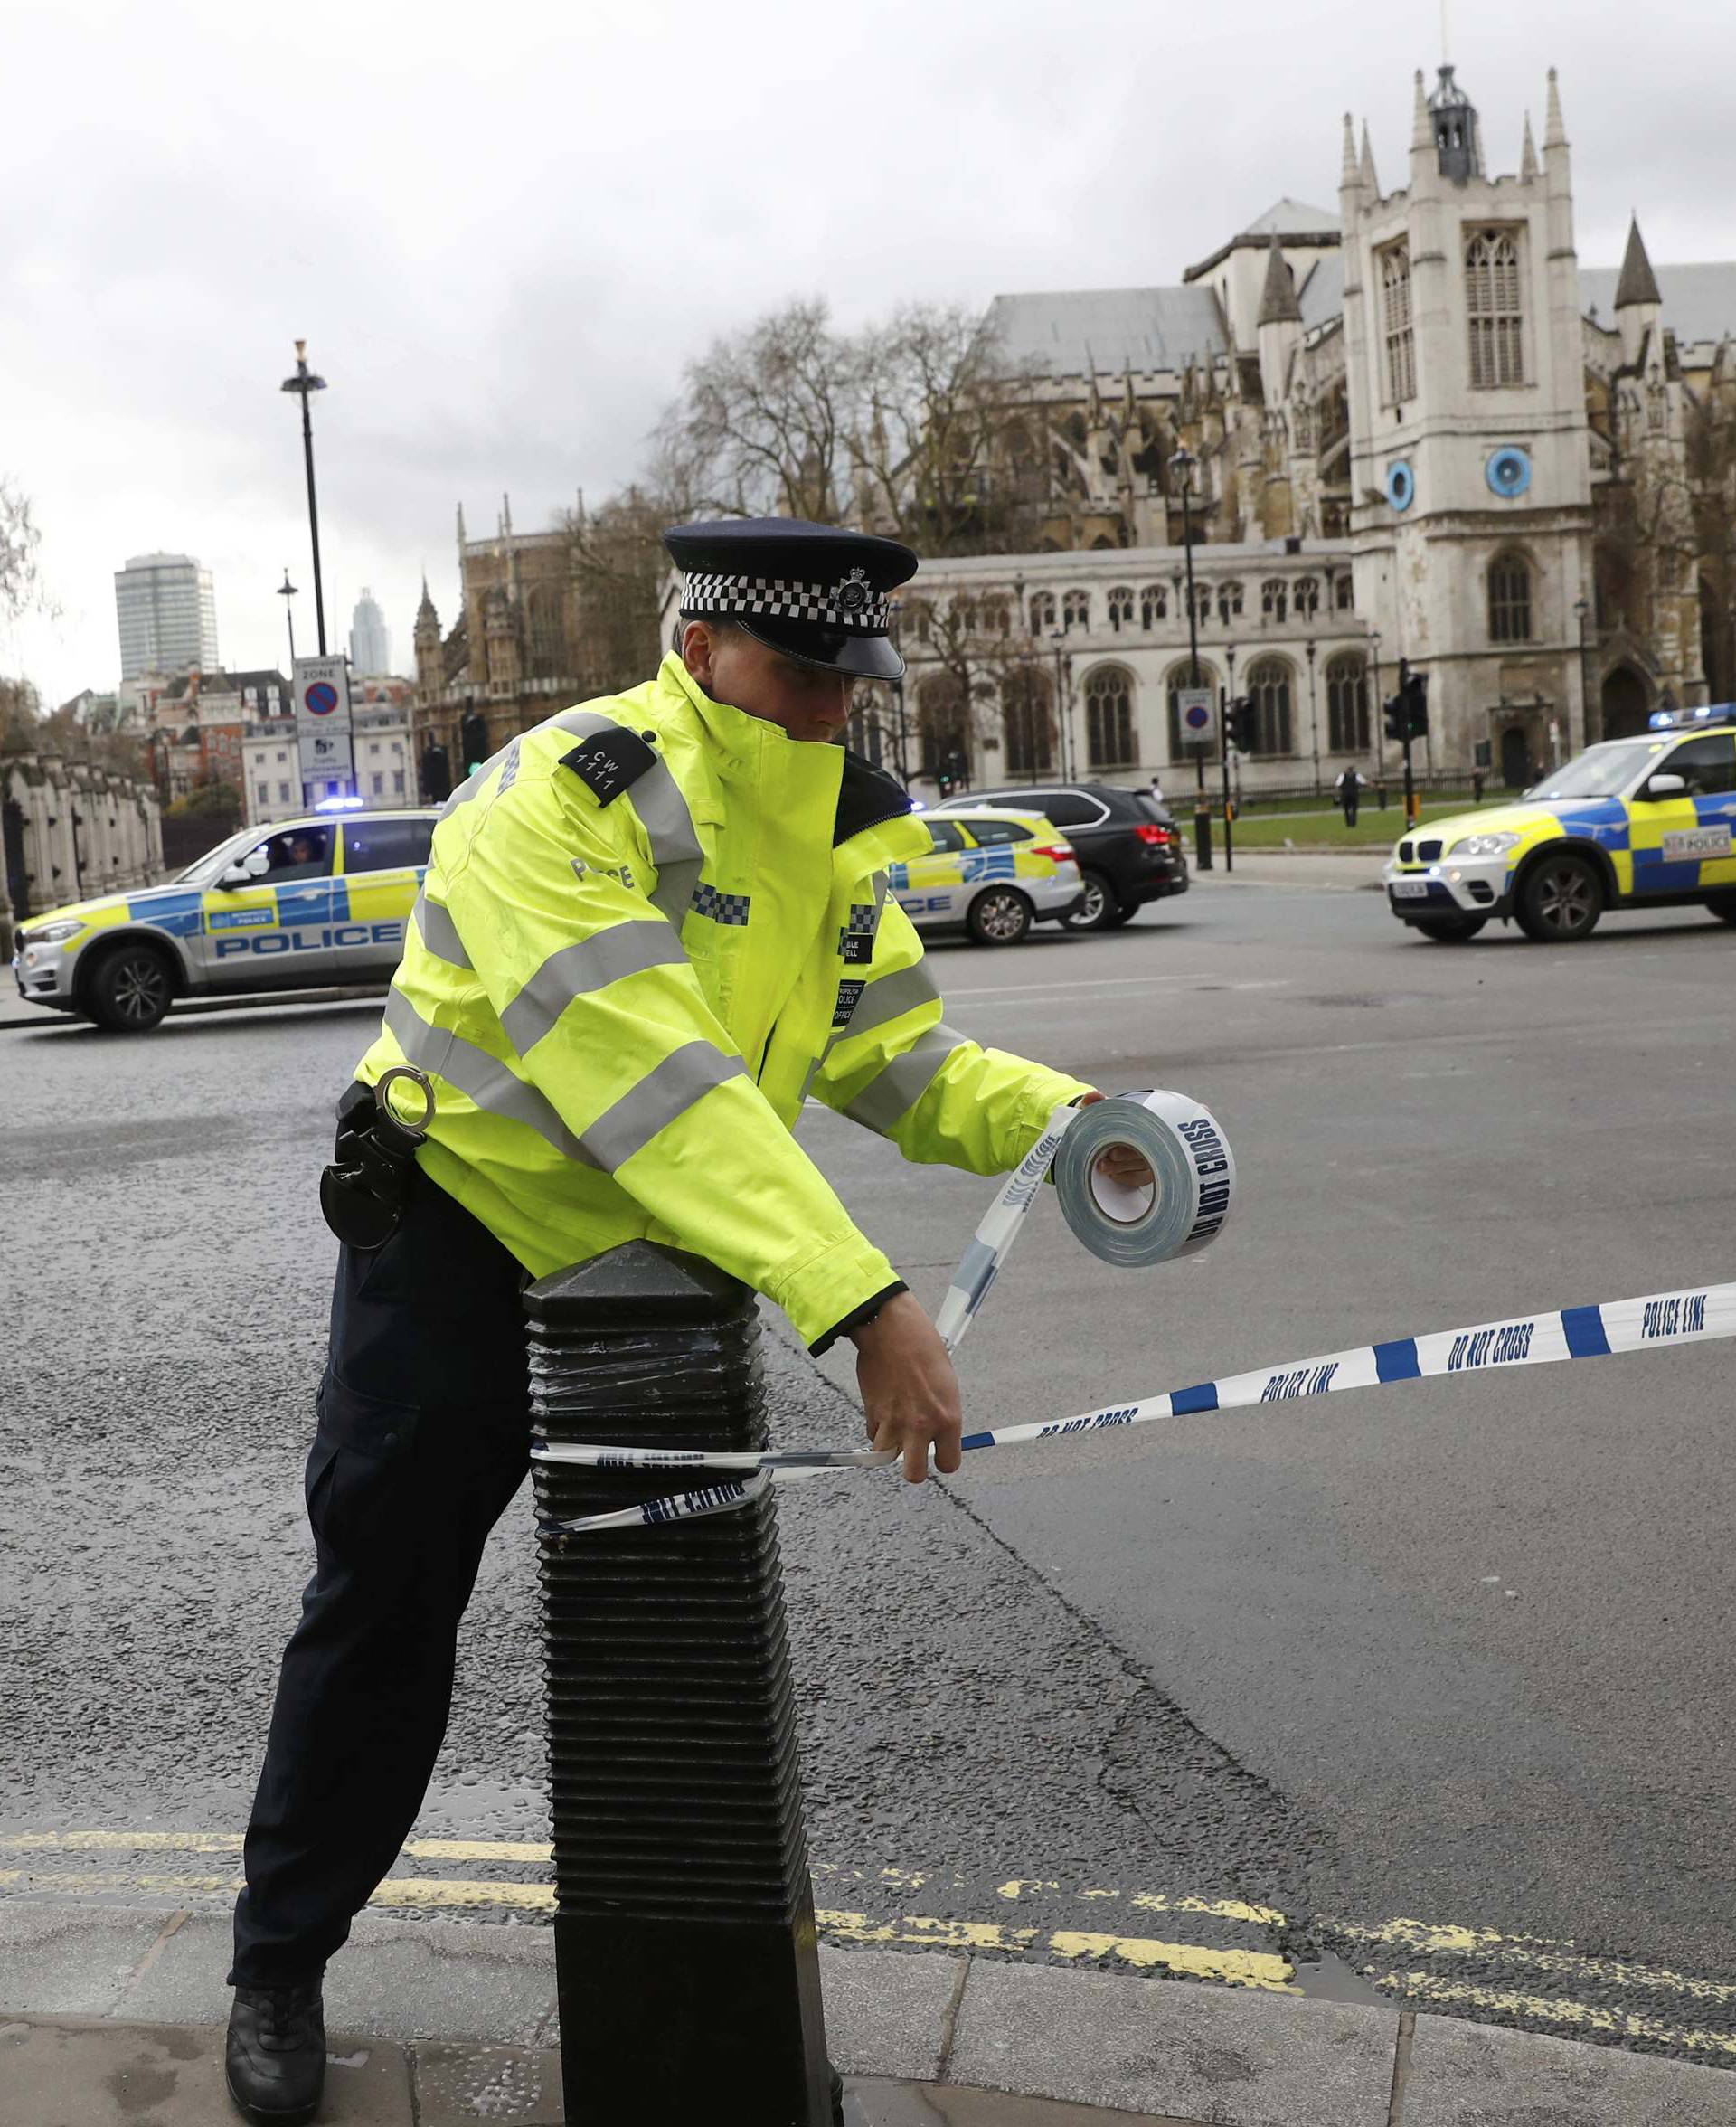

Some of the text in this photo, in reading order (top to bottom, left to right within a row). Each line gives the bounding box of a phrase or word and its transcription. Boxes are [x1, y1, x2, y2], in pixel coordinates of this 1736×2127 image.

[303, 669, 335, 680] ZONE
[576, 753, 616, 789] 1111
[216, 923, 402, 958] POLICE
[1177, 1118, 1231, 1243] DO NOT CROSS
[1641, 1294, 1708, 1339] POLICE LINE
[1448, 1322, 1535, 1372] DO NOT CROSS
[1260, 1361, 1340, 1404] POLICE LINE
